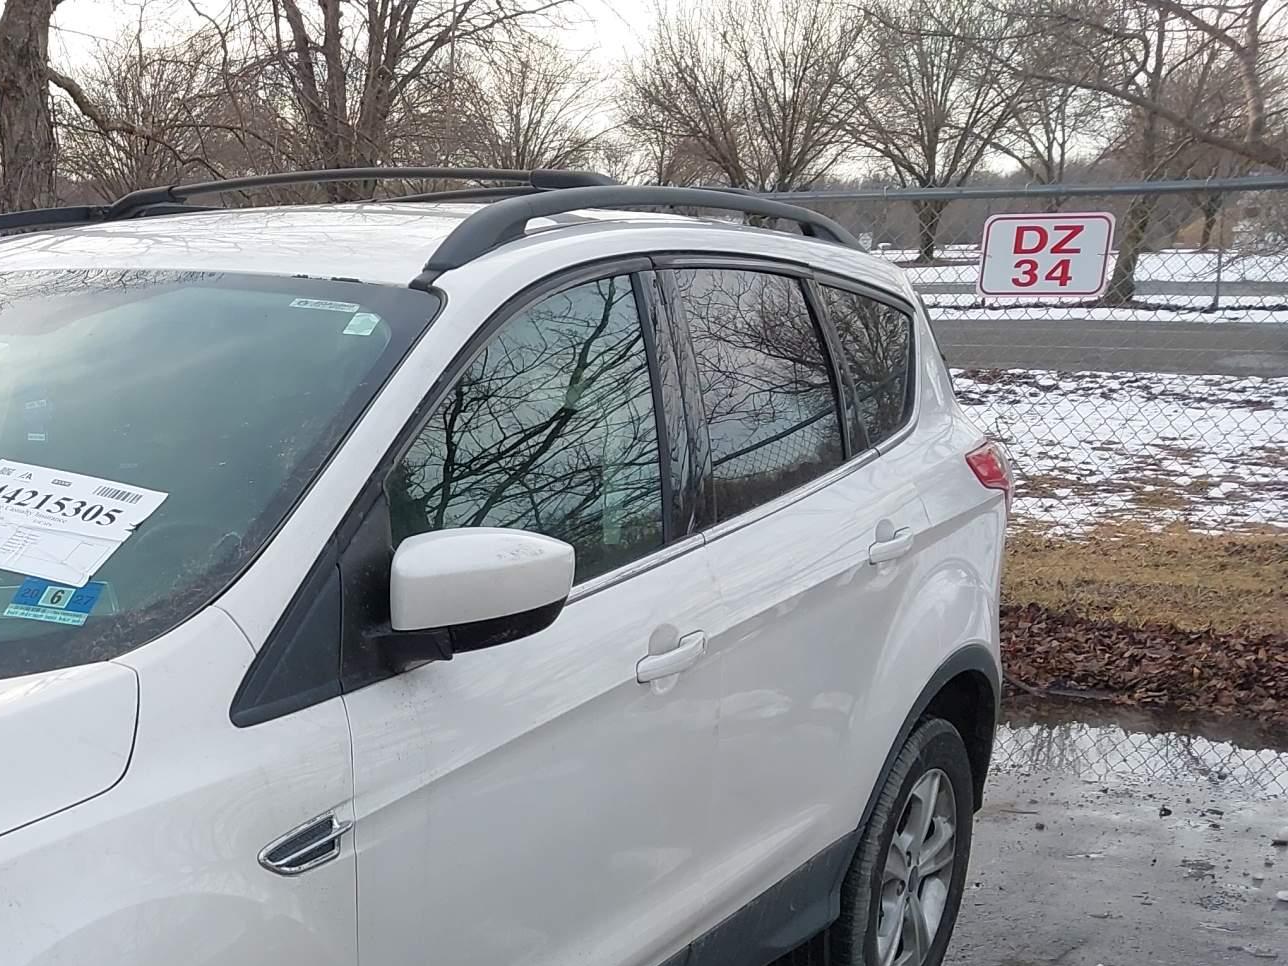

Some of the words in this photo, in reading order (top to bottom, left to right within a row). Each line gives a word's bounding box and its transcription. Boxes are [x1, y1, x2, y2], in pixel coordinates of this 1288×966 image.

[1012, 224, 1085, 255] DZ
[1011, 258, 1073, 287] 34
[33, 511, 69, 525] Insurance
[50, 589, 66, 605] 6
